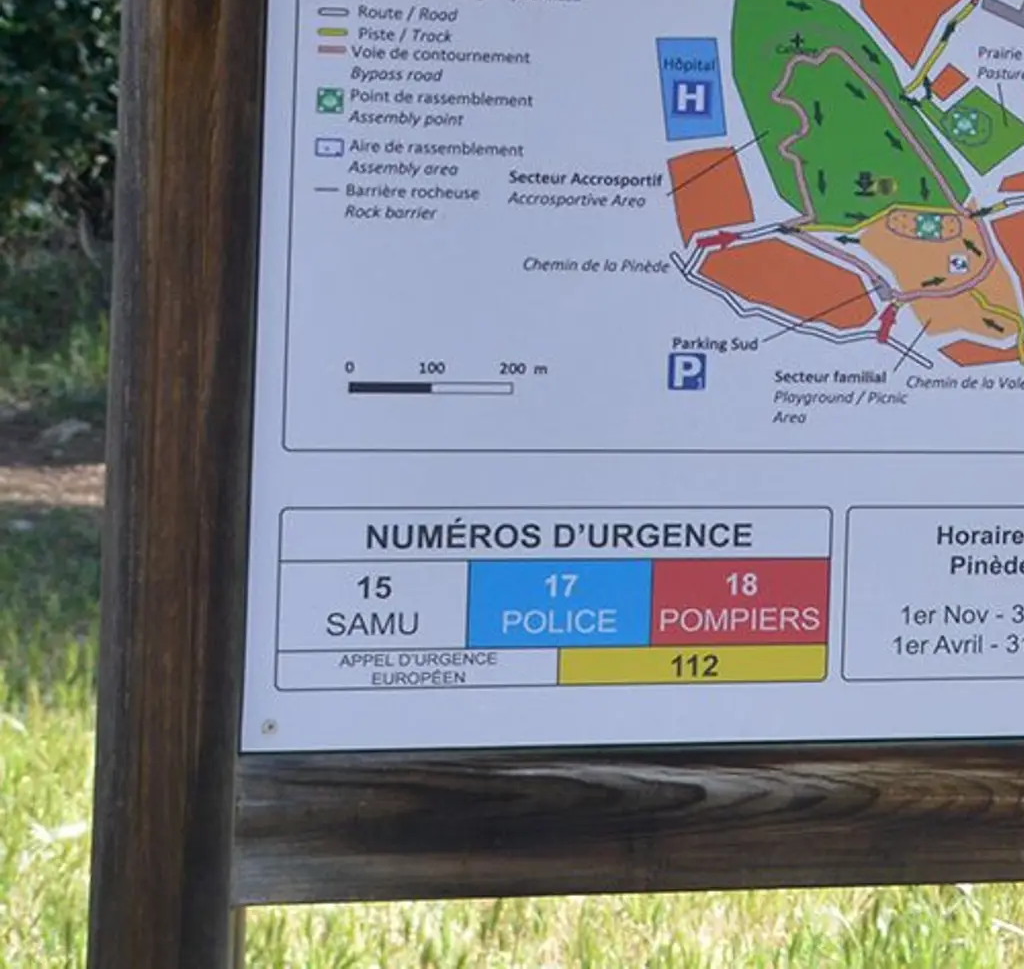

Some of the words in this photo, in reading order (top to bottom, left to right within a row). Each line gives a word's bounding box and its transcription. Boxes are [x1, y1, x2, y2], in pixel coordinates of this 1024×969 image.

[358, 5, 403, 20] Route
[418, 6, 459, 22] Road
[358, 27, 395, 42] Piste
[412, 28, 452, 44] Track
[351, 45, 386, 60] Voie
[389, 47, 408, 60] de
[412, 49, 530, 64] contournement
[978, 46, 1022, 61] Prairie
[350, 66, 403, 82] Bypass
[406, 68, 443, 82] road
[350, 89, 390, 103] Point
[393, 90, 413, 104] de
[417, 92, 533, 107] rassemblement
[677, 83, 705, 111] H
[348, 110, 421, 128] Assembly
[423, 113, 464, 128] point
[349, 140, 381, 153] Aire
[384, 140, 404, 154] de
[407, 142, 524, 157] rassemblement
[348, 160, 421, 178] Assembly
[423, 164, 459, 176] area
[509, 170, 567, 185] Secteur
[570, 172, 663, 189] Accrosportif
[346, 184, 407, 198] Barrière
[410, 186, 480, 200] rocheuse
[610, 194, 646, 208] Area
[344, 204, 381, 219] Rock
[385, 206, 437, 220] barrier
[522, 256, 578, 272] Chemin
[581, 259, 600, 272] de
[603, 259, 617, 272] la
[620, 258, 669, 273] Pinède
[672, 336, 727, 353] Parking
[730, 337, 758, 351] Sud
[419, 361, 445, 374] 100
[499, 362, 526, 375] 200
[774, 370, 830, 383] Secteur
[833, 370, 887, 383] familial
[906, 375, 958, 389] Chemin
[960, 376, 978, 389] de
[981, 376, 995, 389] la
[773, 390, 855, 406] Playground
[867, 391, 908, 405] Picnic
[772, 411, 807, 424] Area
[366, 518, 541, 549] NUMÉROS
[553, 523, 752, 548] D'URGENCE
[357, 575, 392, 599] 15
[545, 574, 578, 597] 17
[726, 572, 757, 595] 18
[502, 609, 617, 634] POLICE
[659, 606, 820, 632] POMPIERS
[901, 605, 936, 626] 1er
[944, 604, 989, 624] Nov
[326, 612, 418, 636] SAMU
[893, 634, 929, 655] 1er
[933, 633, 983, 654] Avril
[339, 654, 393, 667] APPEL
[398, 651, 497, 666] D'URGENCE
[671, 654, 718, 677] 112
